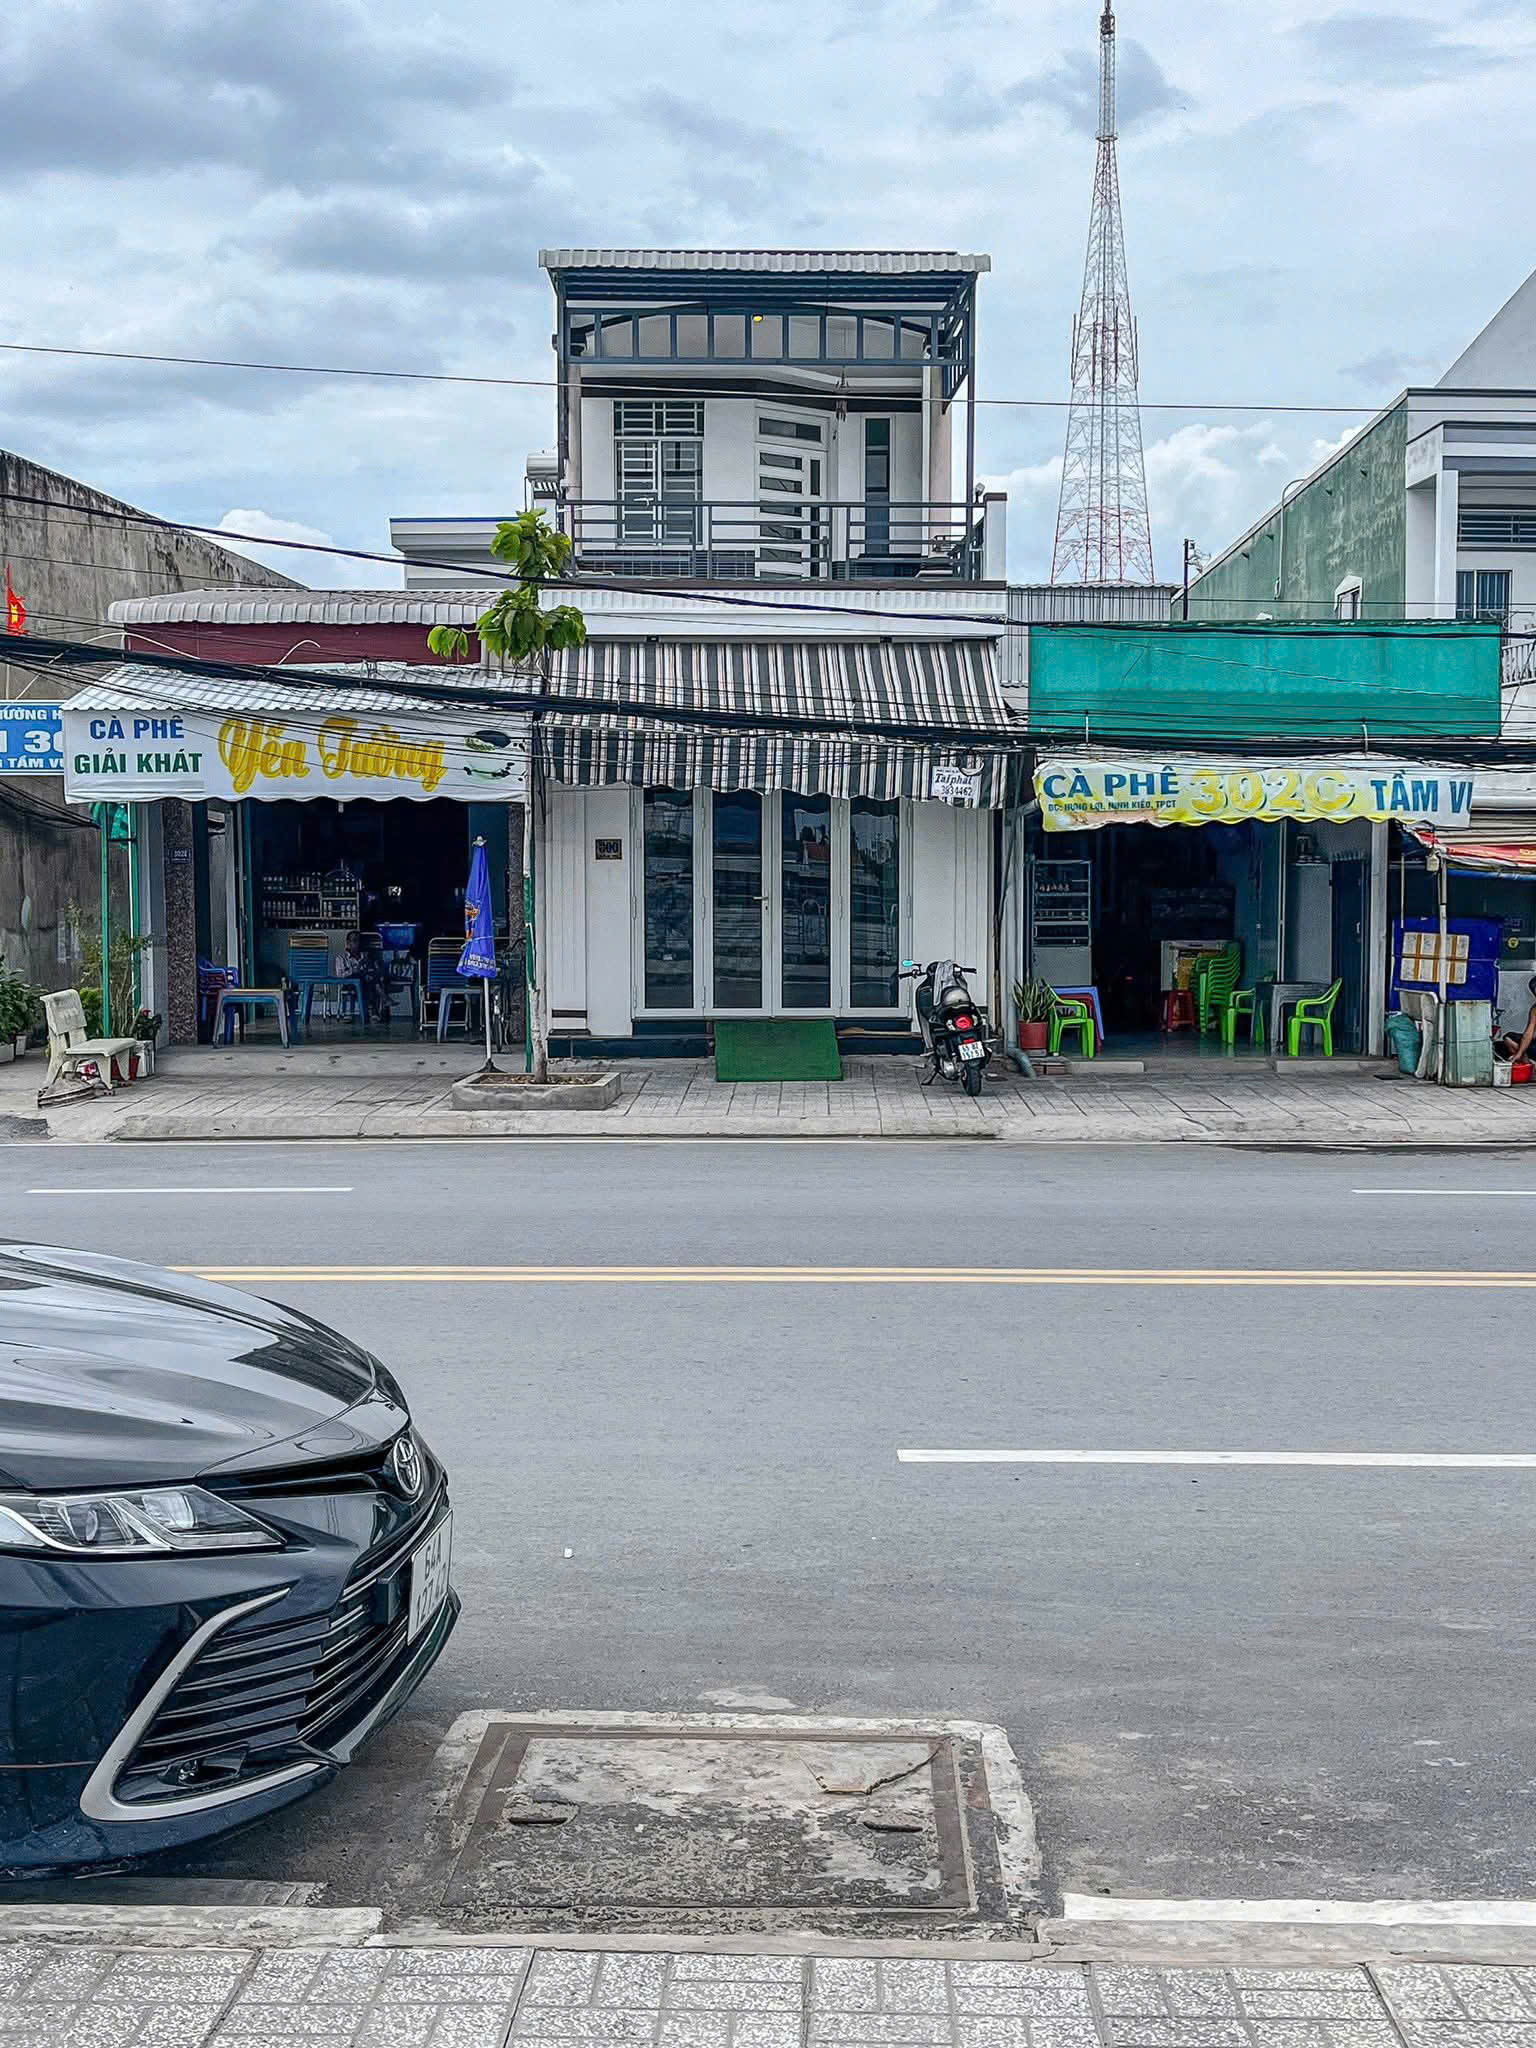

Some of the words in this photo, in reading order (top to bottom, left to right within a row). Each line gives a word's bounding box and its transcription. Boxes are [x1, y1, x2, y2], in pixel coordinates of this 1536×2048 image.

[89, 715, 125, 739] CÀ
[133, 715, 185, 739] PHÊ
[74, 748, 126, 774] GIẢI
[136, 748, 203, 773] KHÁT
[1042, 768, 1093, 798] CÀ
[1103, 765, 1180, 796] PHÊ
[1190, 768, 1355, 814] 302C
[1370, 769, 1439, 812] TẦM
[425, 1531, 441, 1581] 64A
